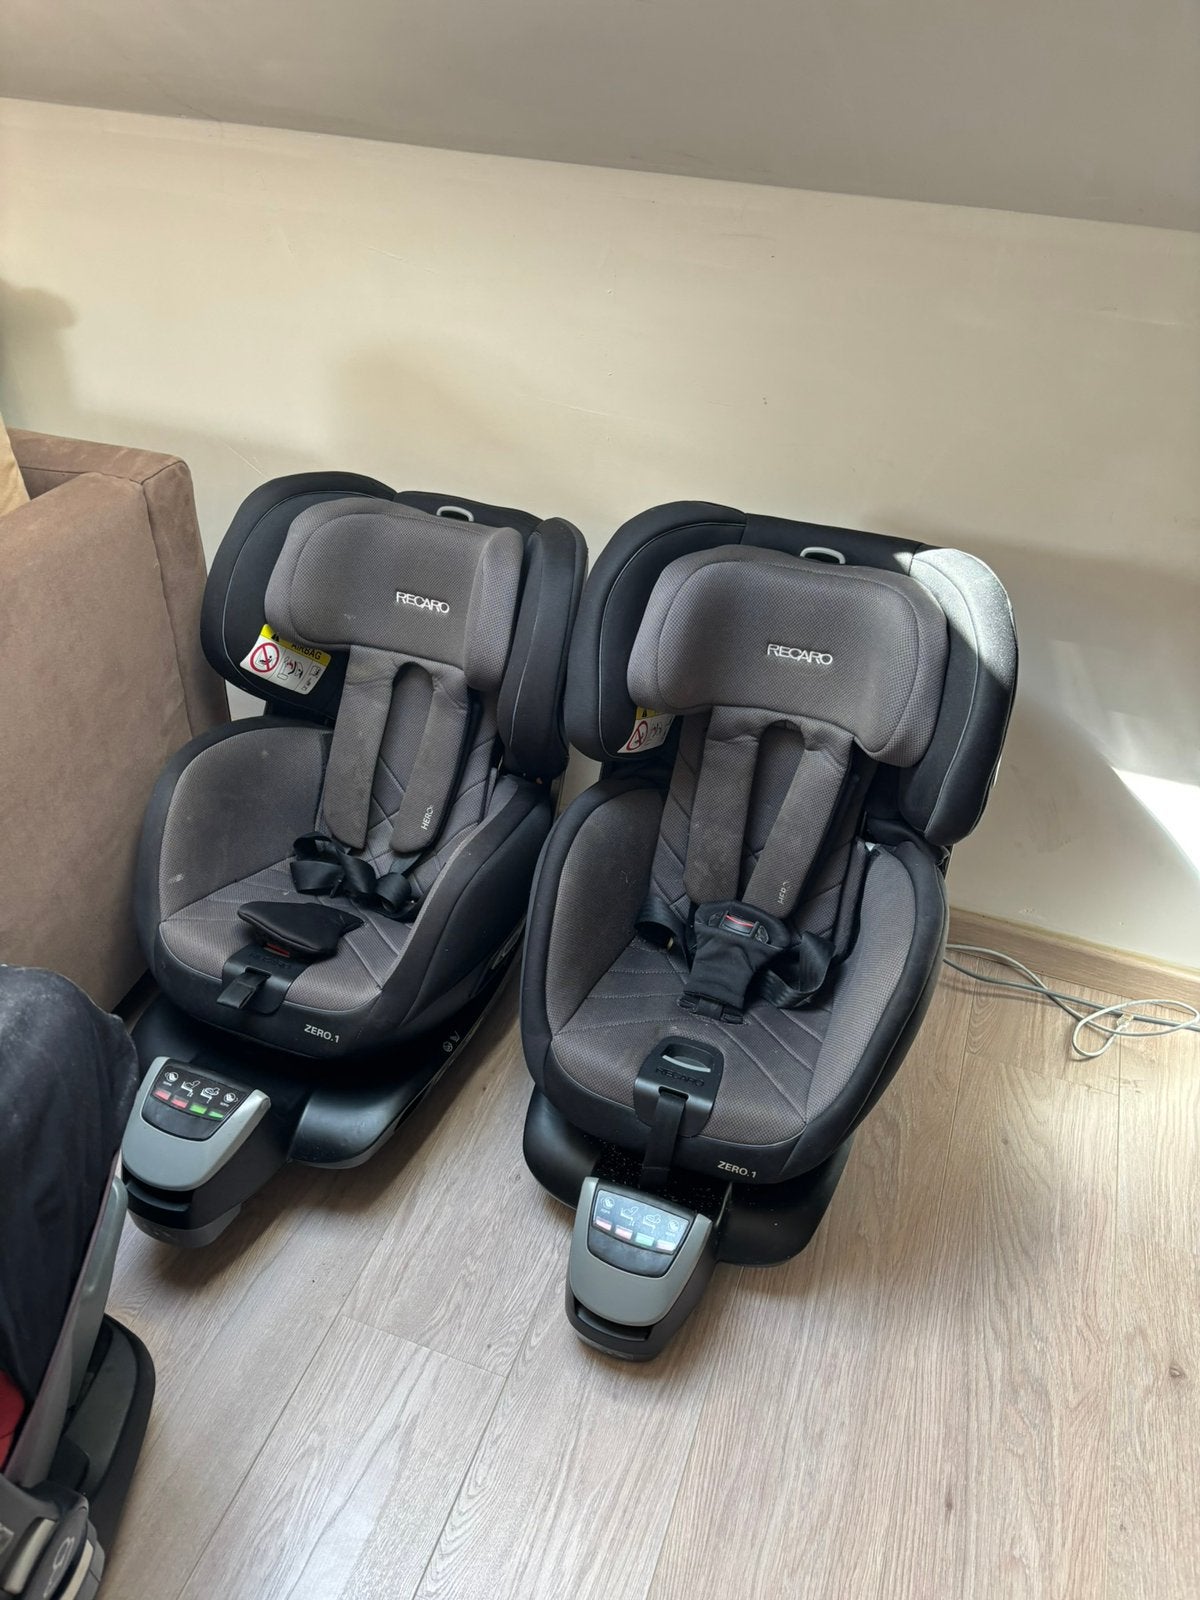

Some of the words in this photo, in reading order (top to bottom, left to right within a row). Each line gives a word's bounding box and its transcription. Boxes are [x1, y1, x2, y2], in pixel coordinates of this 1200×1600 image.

[396, 591, 450, 614] RECARO
[767, 643, 833, 665] RECARO
[304, 1023, 340, 1043] ZERO.1
